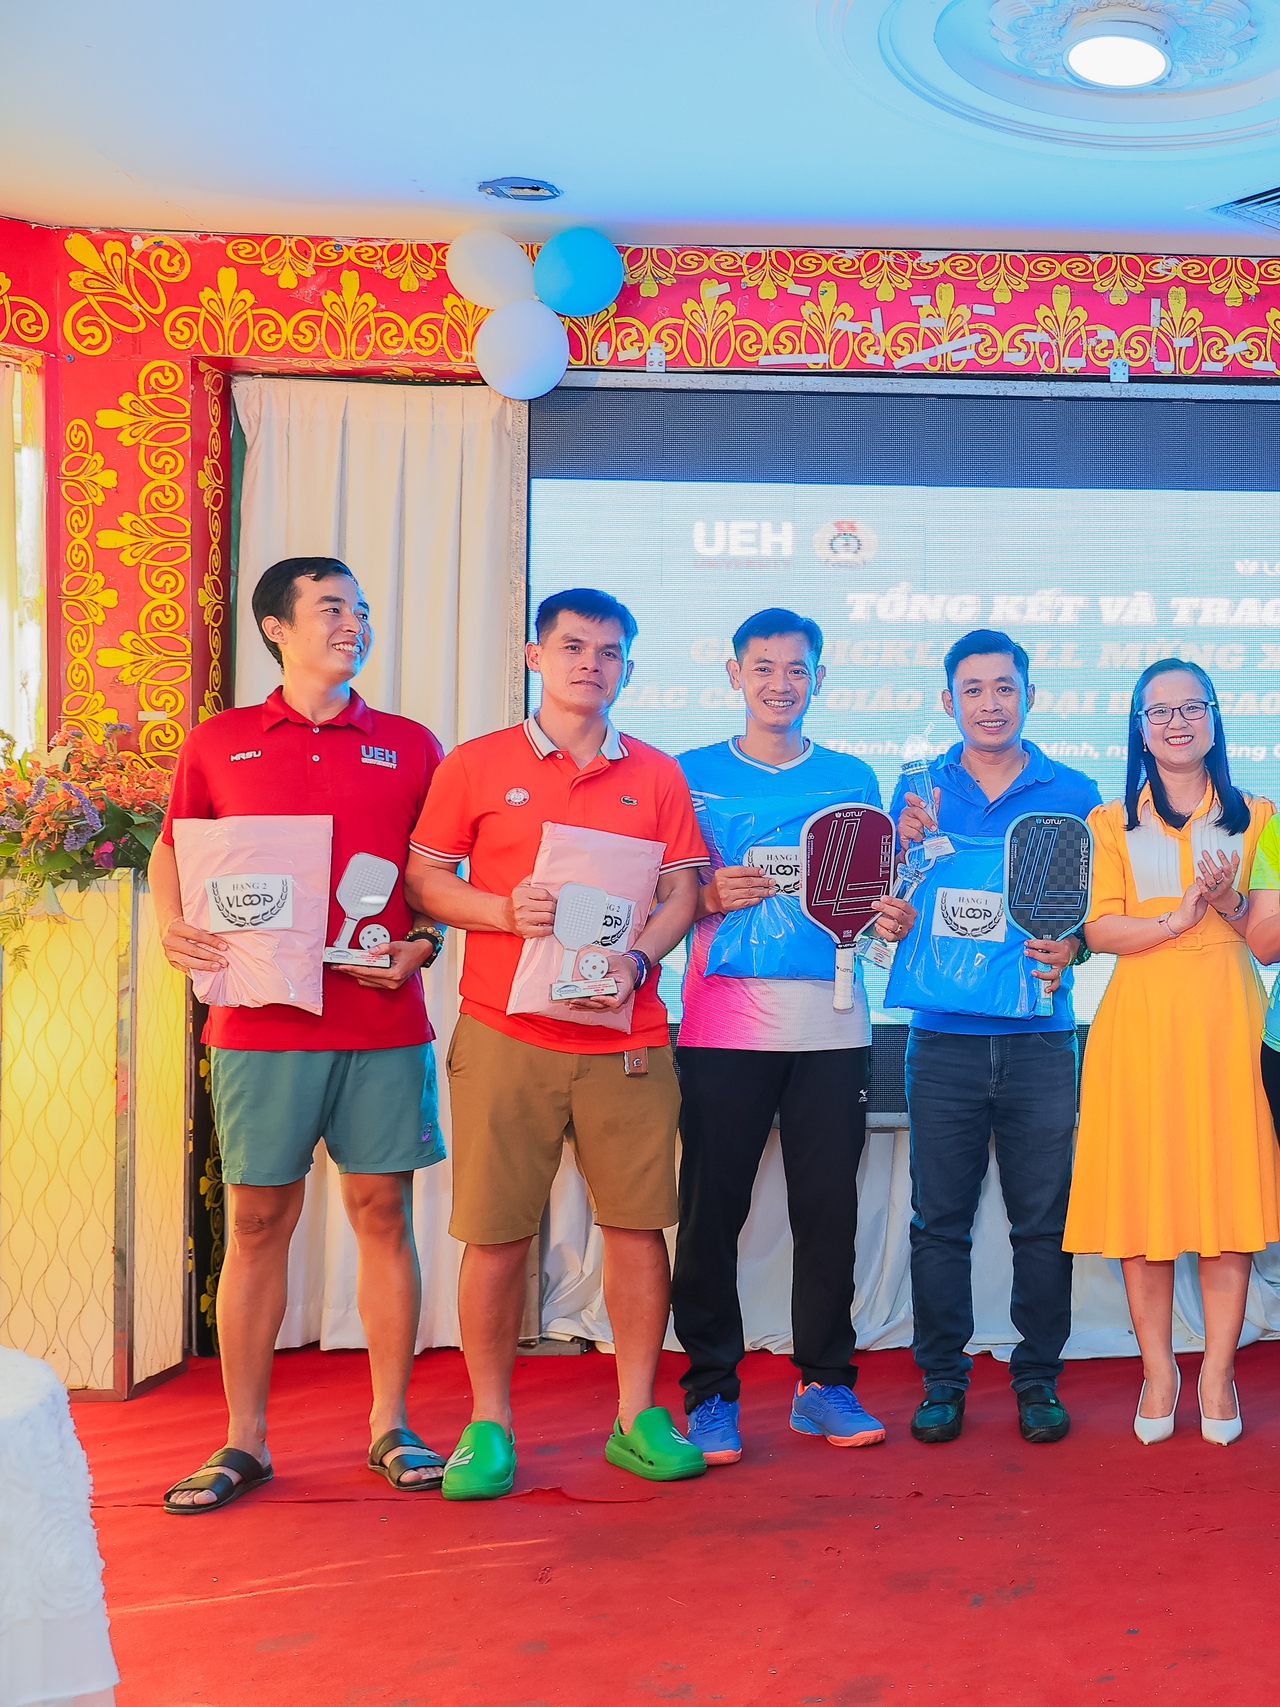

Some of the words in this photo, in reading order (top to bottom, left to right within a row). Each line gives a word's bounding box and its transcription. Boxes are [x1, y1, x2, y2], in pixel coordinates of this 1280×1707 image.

[692, 519, 793, 557] UEH
[846, 581, 981, 623] TỔNG
[987, 587, 1089, 625] KẾT
[1098, 590, 1158, 627] VÀ
[824, 682, 924, 712] GIÁO
[361, 745, 397, 763] UEH
[766, 854, 792, 863] HẠNG
[1079, 837, 1089, 891] ZEPHYRE
[232, 882, 260, 892] HẠNG
[262, 882, 267, 890] 2
[226, 893, 274, 908] VLOOP
[958, 896, 984, 905] HẠNG
[951, 906, 992, 920] VLOOP
